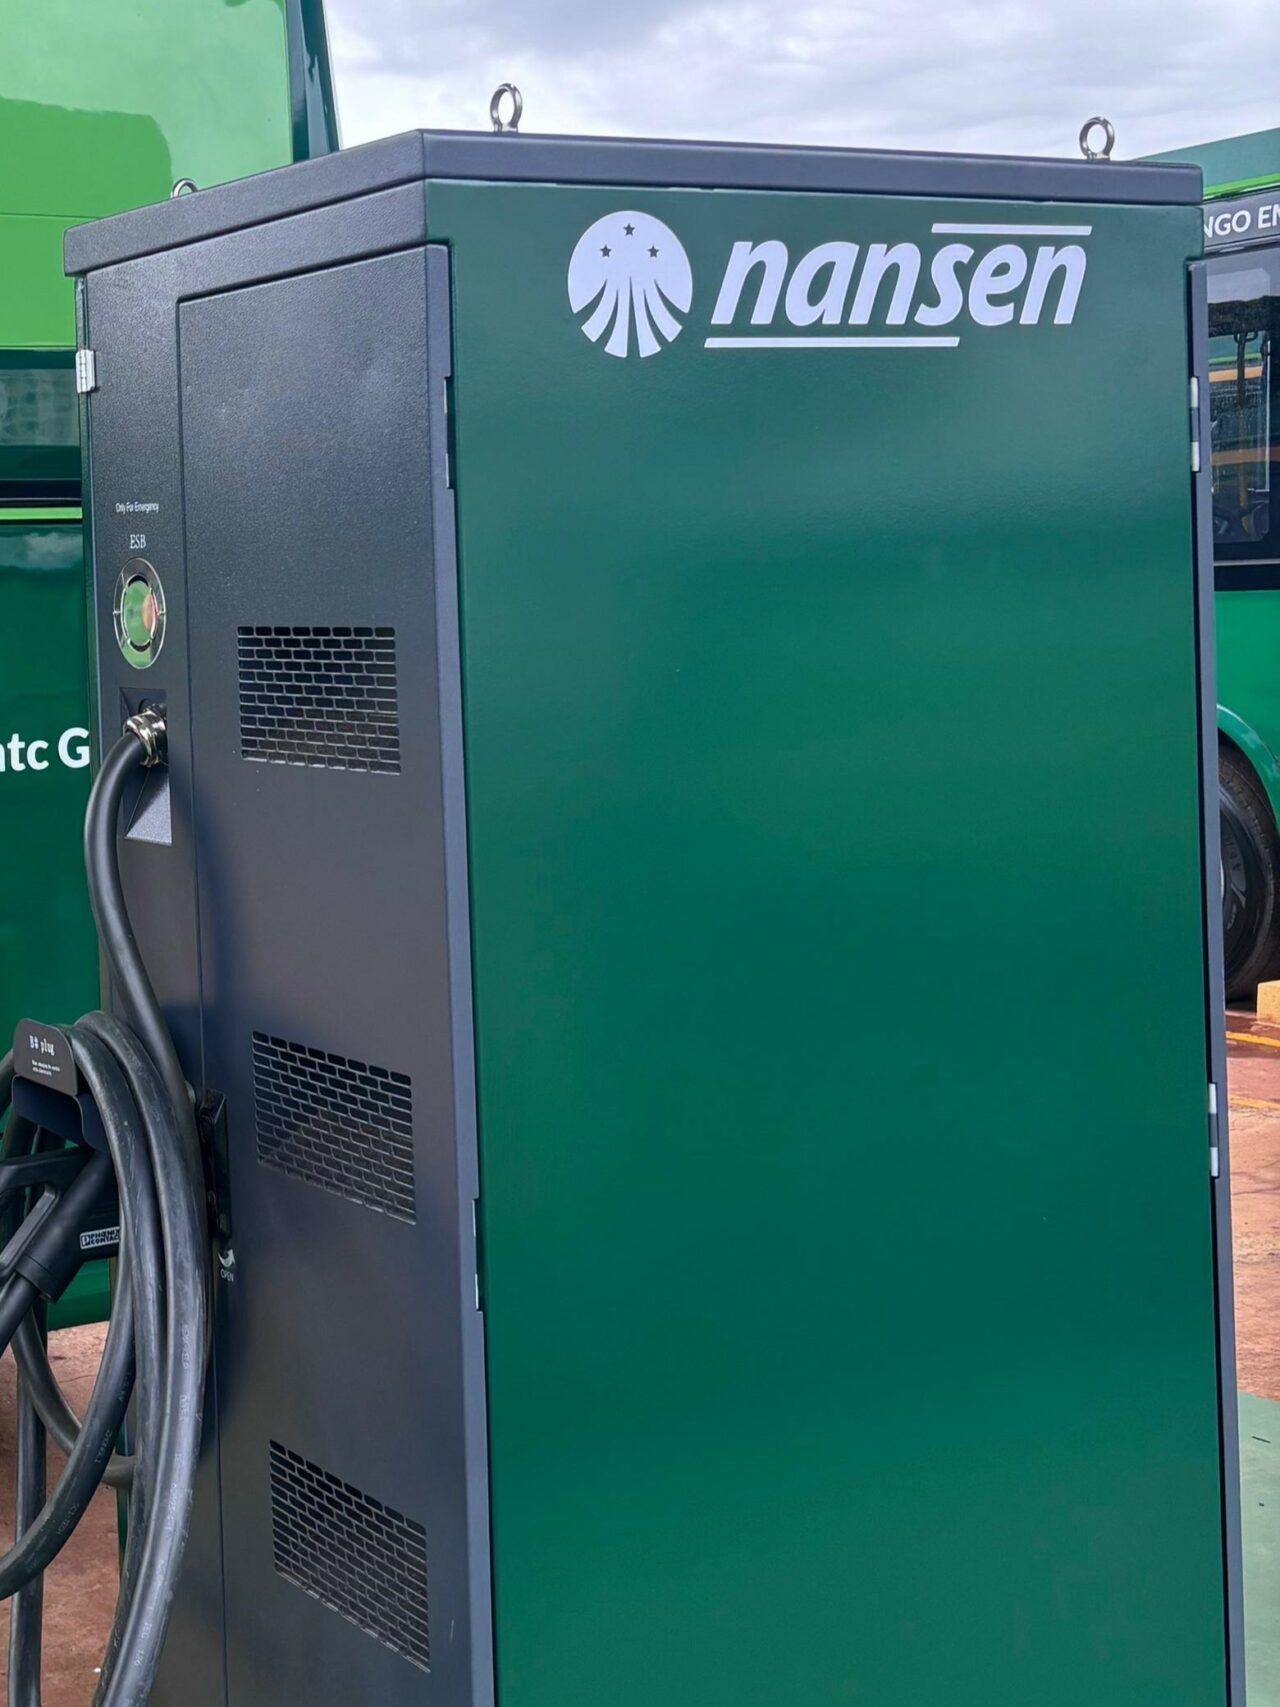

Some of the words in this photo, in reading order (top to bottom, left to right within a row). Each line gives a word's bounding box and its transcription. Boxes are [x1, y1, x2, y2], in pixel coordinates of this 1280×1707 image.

[709, 240, 1087, 327] nansen
[134, 501, 159, 514] Emergency
[129, 534, 146, 549] ESB
